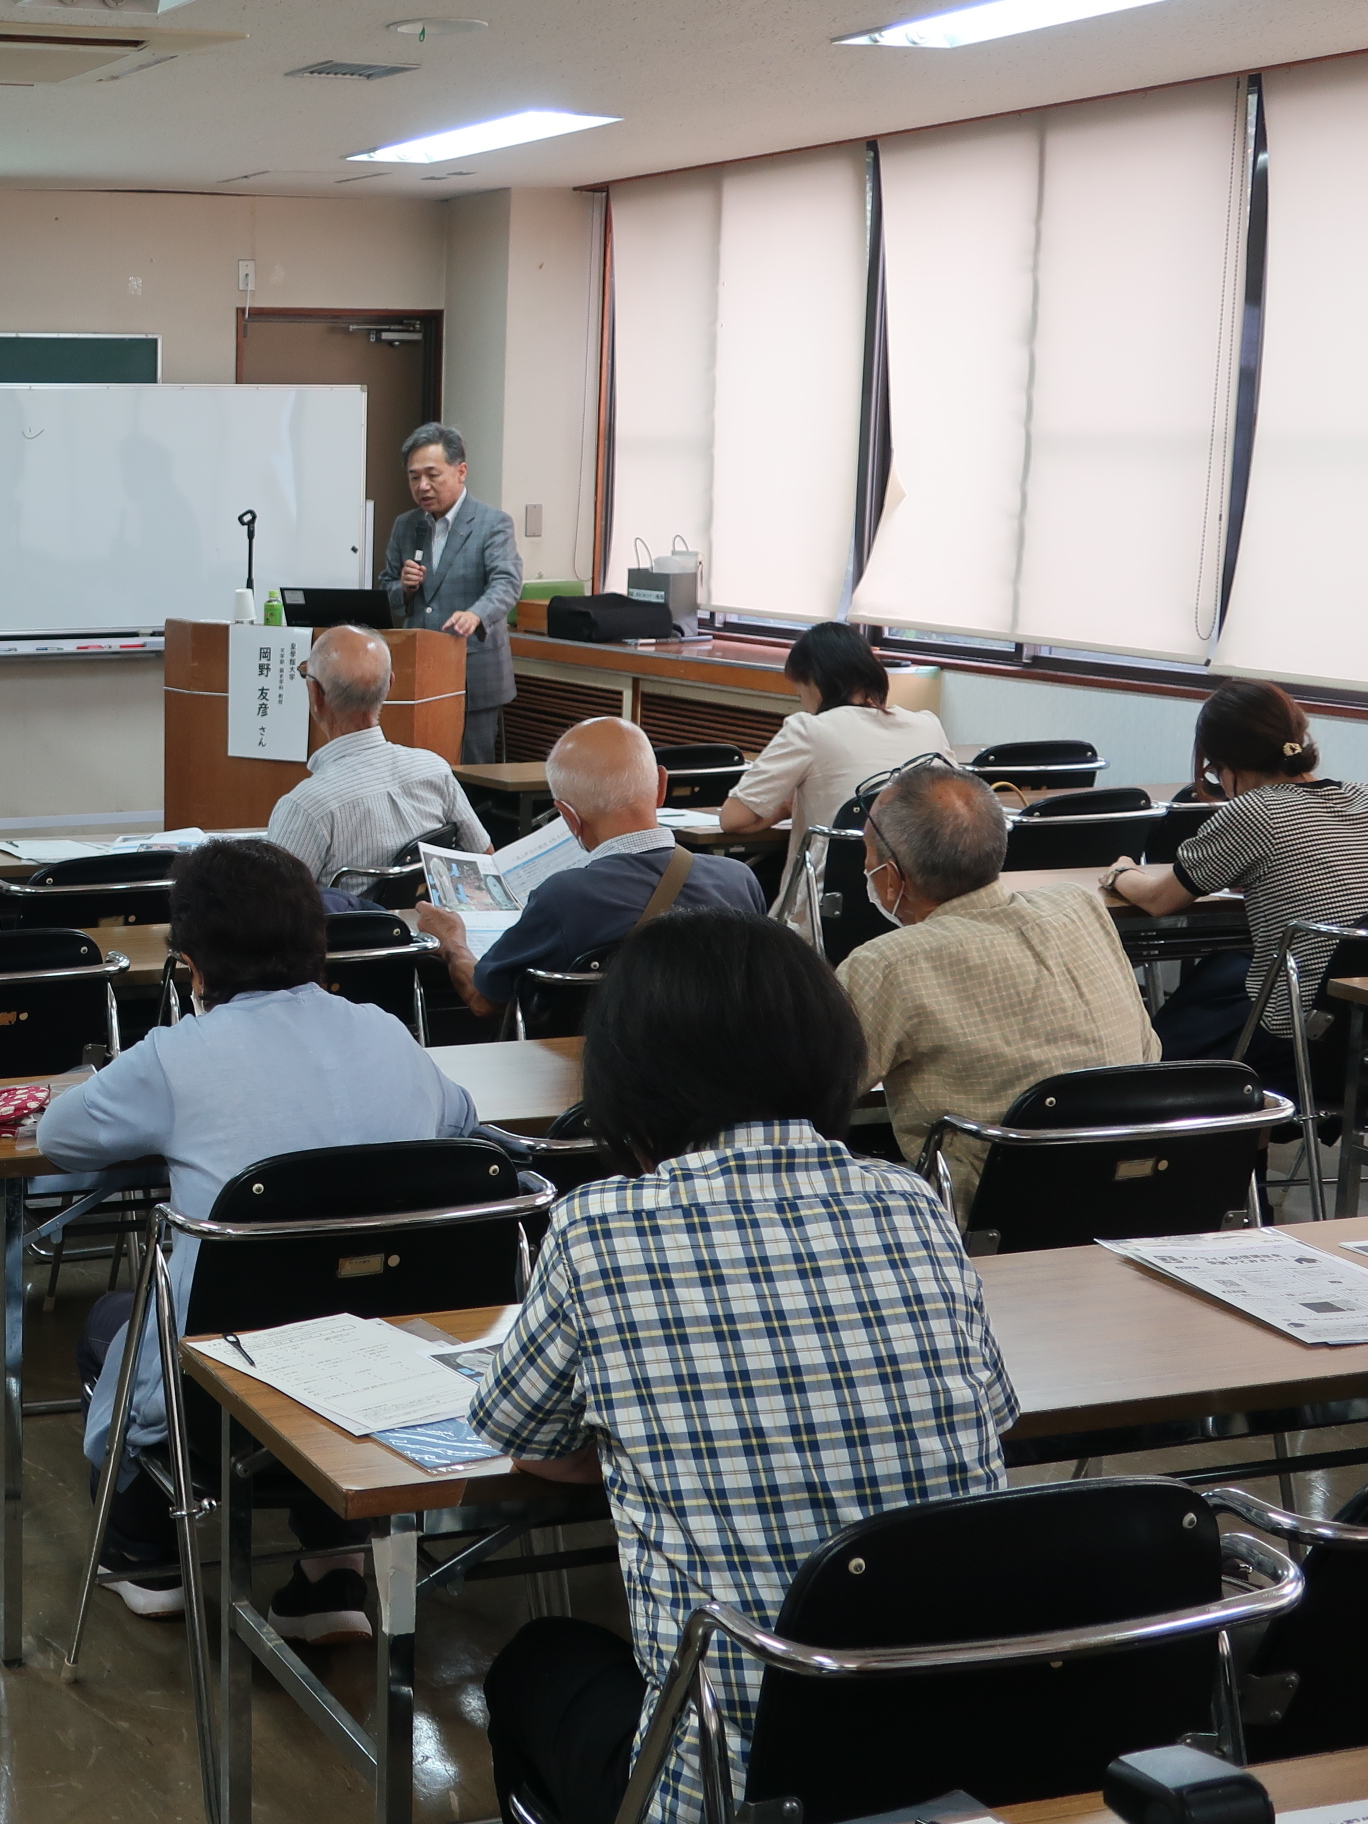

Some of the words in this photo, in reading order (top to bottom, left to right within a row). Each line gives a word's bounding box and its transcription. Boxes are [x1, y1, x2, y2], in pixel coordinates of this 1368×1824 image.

[258, 647, 271, 677] 岡野
[257, 686, 269, 717] 友彦
[258, 726, 266, 747] さん
